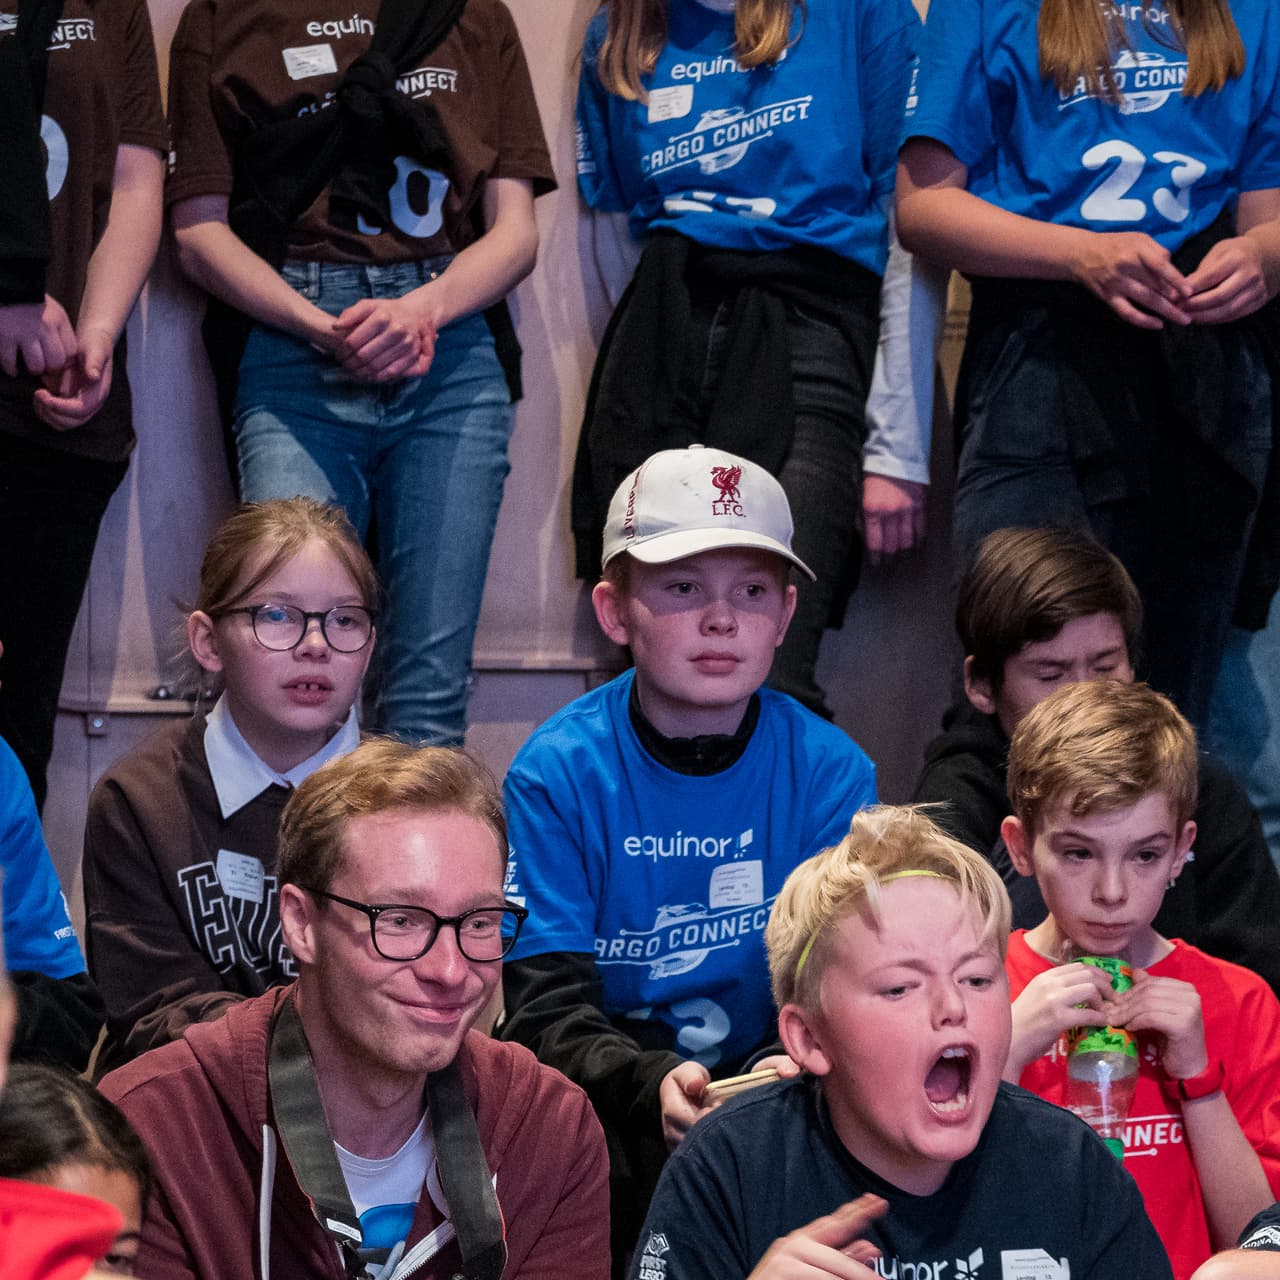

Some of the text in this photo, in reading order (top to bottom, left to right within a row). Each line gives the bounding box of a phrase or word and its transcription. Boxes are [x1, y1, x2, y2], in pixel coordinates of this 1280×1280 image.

[640, 135, 706, 174] CARGO
[712, 101, 811, 148] CONNECT
[1080, 139, 1208, 223] 23
[623, 830, 733, 864] equinor
